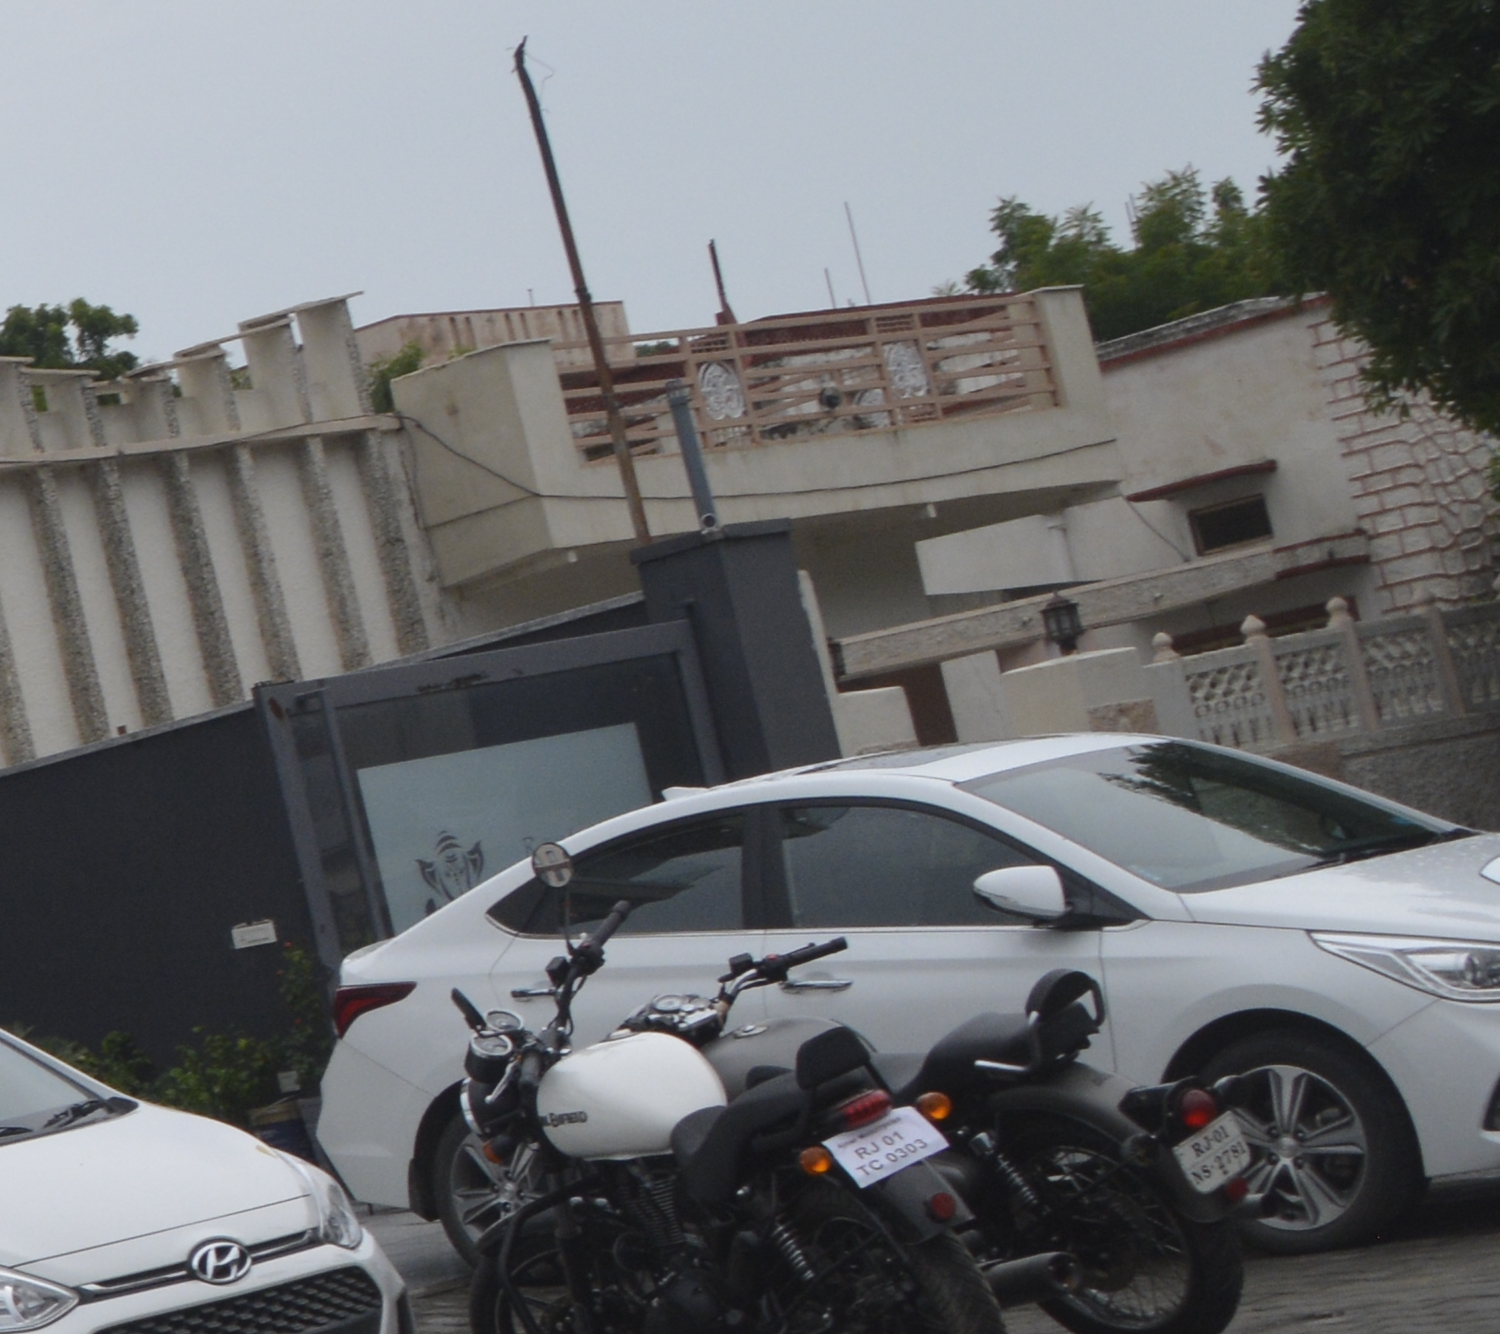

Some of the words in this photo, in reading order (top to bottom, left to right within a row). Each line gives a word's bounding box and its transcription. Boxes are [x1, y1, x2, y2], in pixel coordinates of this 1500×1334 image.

[855, 1142, 880, 1159] RJ
[882, 1131, 904, 1146] 01
[856, 1159, 884, 1176] TC
[885, 1138, 928, 1163] 0303
